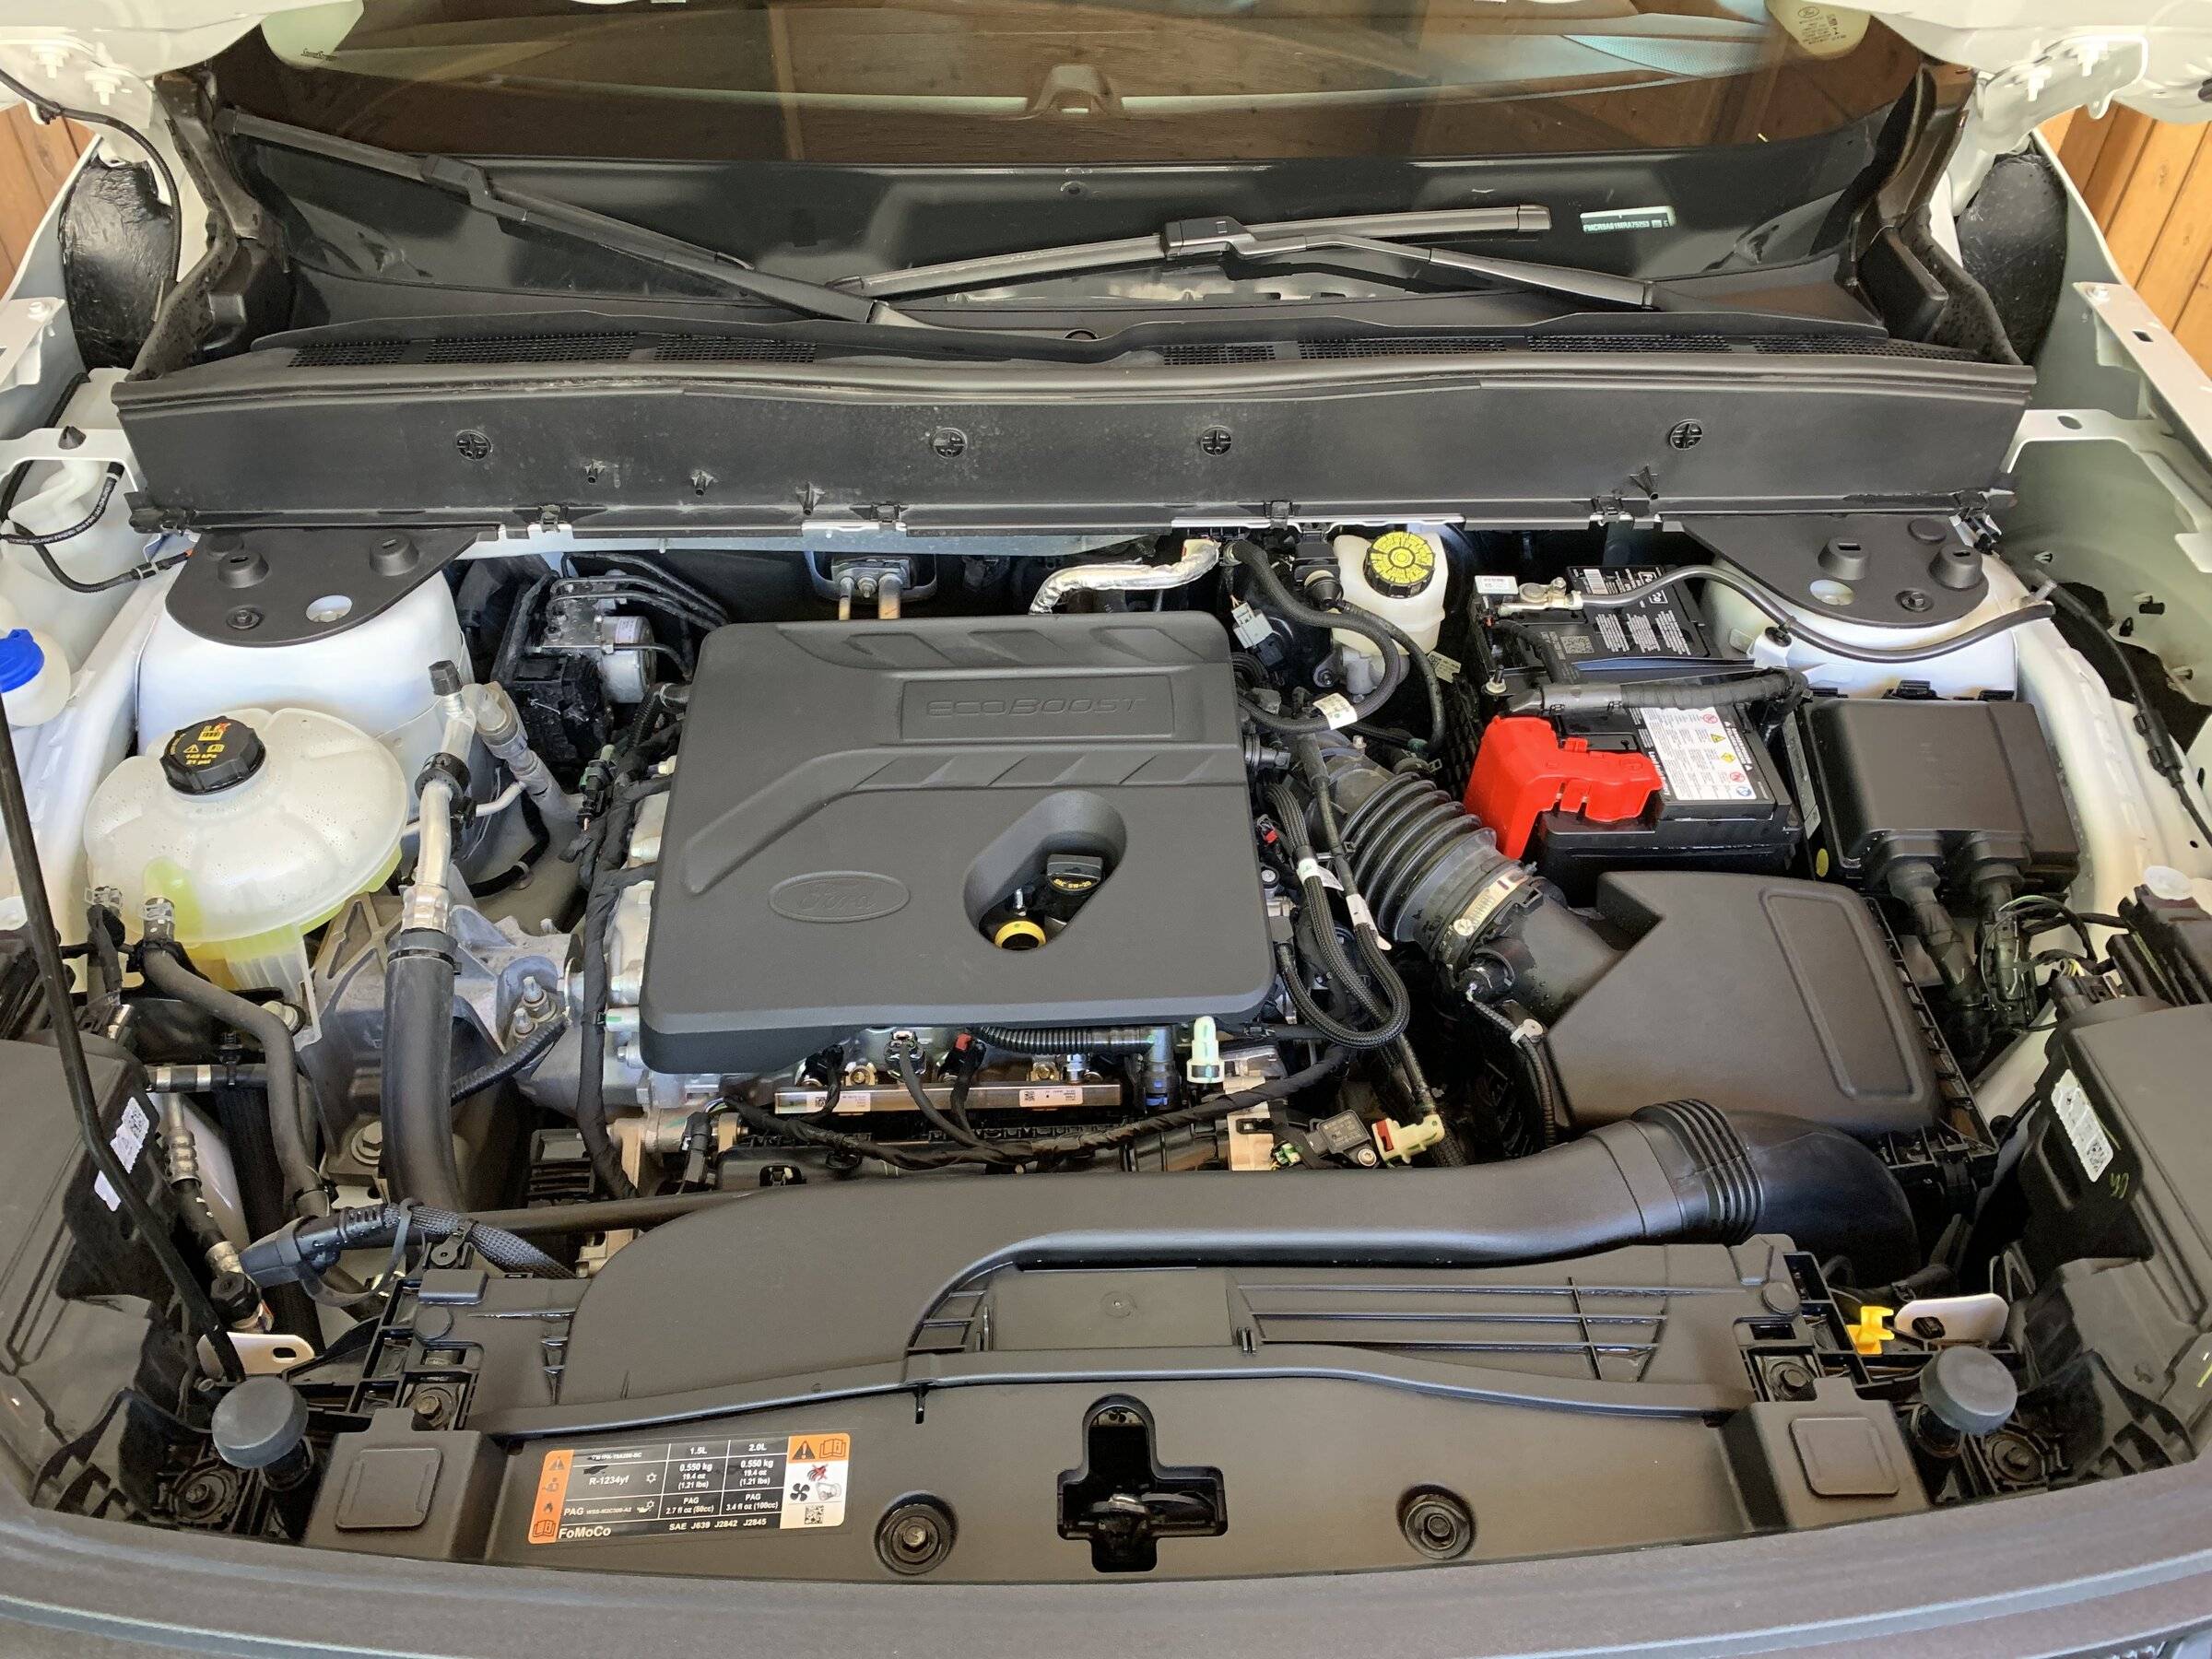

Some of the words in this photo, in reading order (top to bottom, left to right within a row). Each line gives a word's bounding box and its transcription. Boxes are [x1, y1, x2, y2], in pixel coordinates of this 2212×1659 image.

[690, 1446, 708, 1454] 1.5L
[748, 1443, 767, 1452] 2.0L
[679, 1462, 702, 1472] 0.550
[702, 1462, 713, 1472] kg
[740, 1459, 763, 1469] 0.550
[763, 1458, 774, 1468] kg
[589, 1475, 629, 1486] R-1234yf
[677, 1481, 695, 1490] (1.21
[696, 1479, 710, 1489] lbs)
[739, 1477, 756, 1487] (1.21
[757, 1477, 771, 1487] lbs)
[683, 1496, 700, 1504] PAG
[745, 1493, 761, 1501] PAG
[563, 1507, 584, 1516] PAG
[665, 1507, 677, 1515] 2.7
[726, 1503, 737, 1512] 3.4
[668, 1523, 688, 1531] SAE
[558, 1525, 612, 1539] FoMoCo
